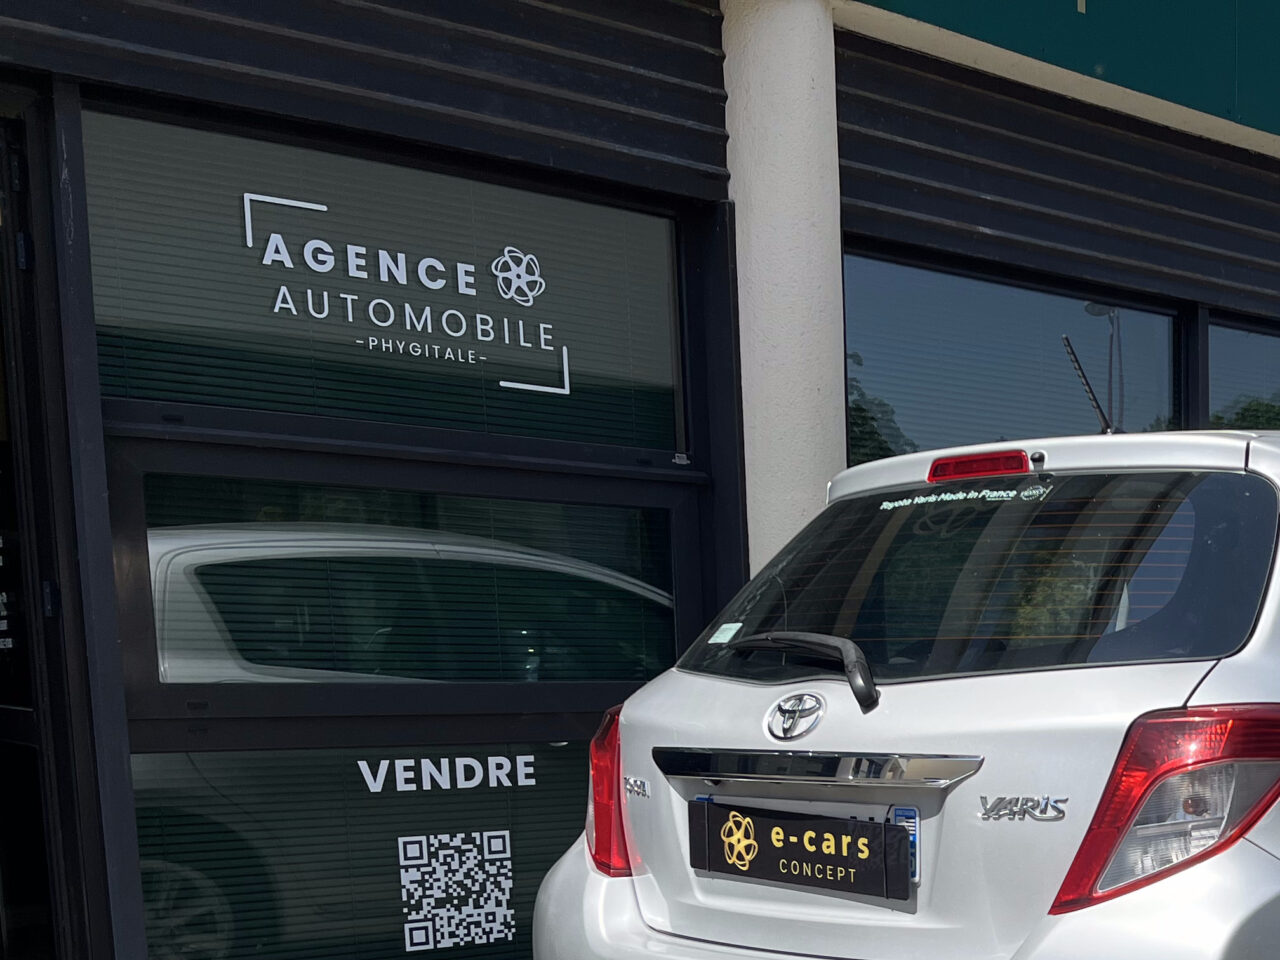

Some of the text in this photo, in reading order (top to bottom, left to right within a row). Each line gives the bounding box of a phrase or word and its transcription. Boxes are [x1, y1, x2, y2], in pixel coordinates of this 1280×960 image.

[262, 232, 478, 296] AGENCE
[273, 285, 555, 351] AUTOMOBILE
[938, 490, 967, 501] Made
[967, 490, 979, 499] in
[979, 489, 1018, 499] France
[357, 755, 536, 793] VENDRE
[770, 825, 871, 860] e-cars
[779, 858, 857, 883] CONCEPT
